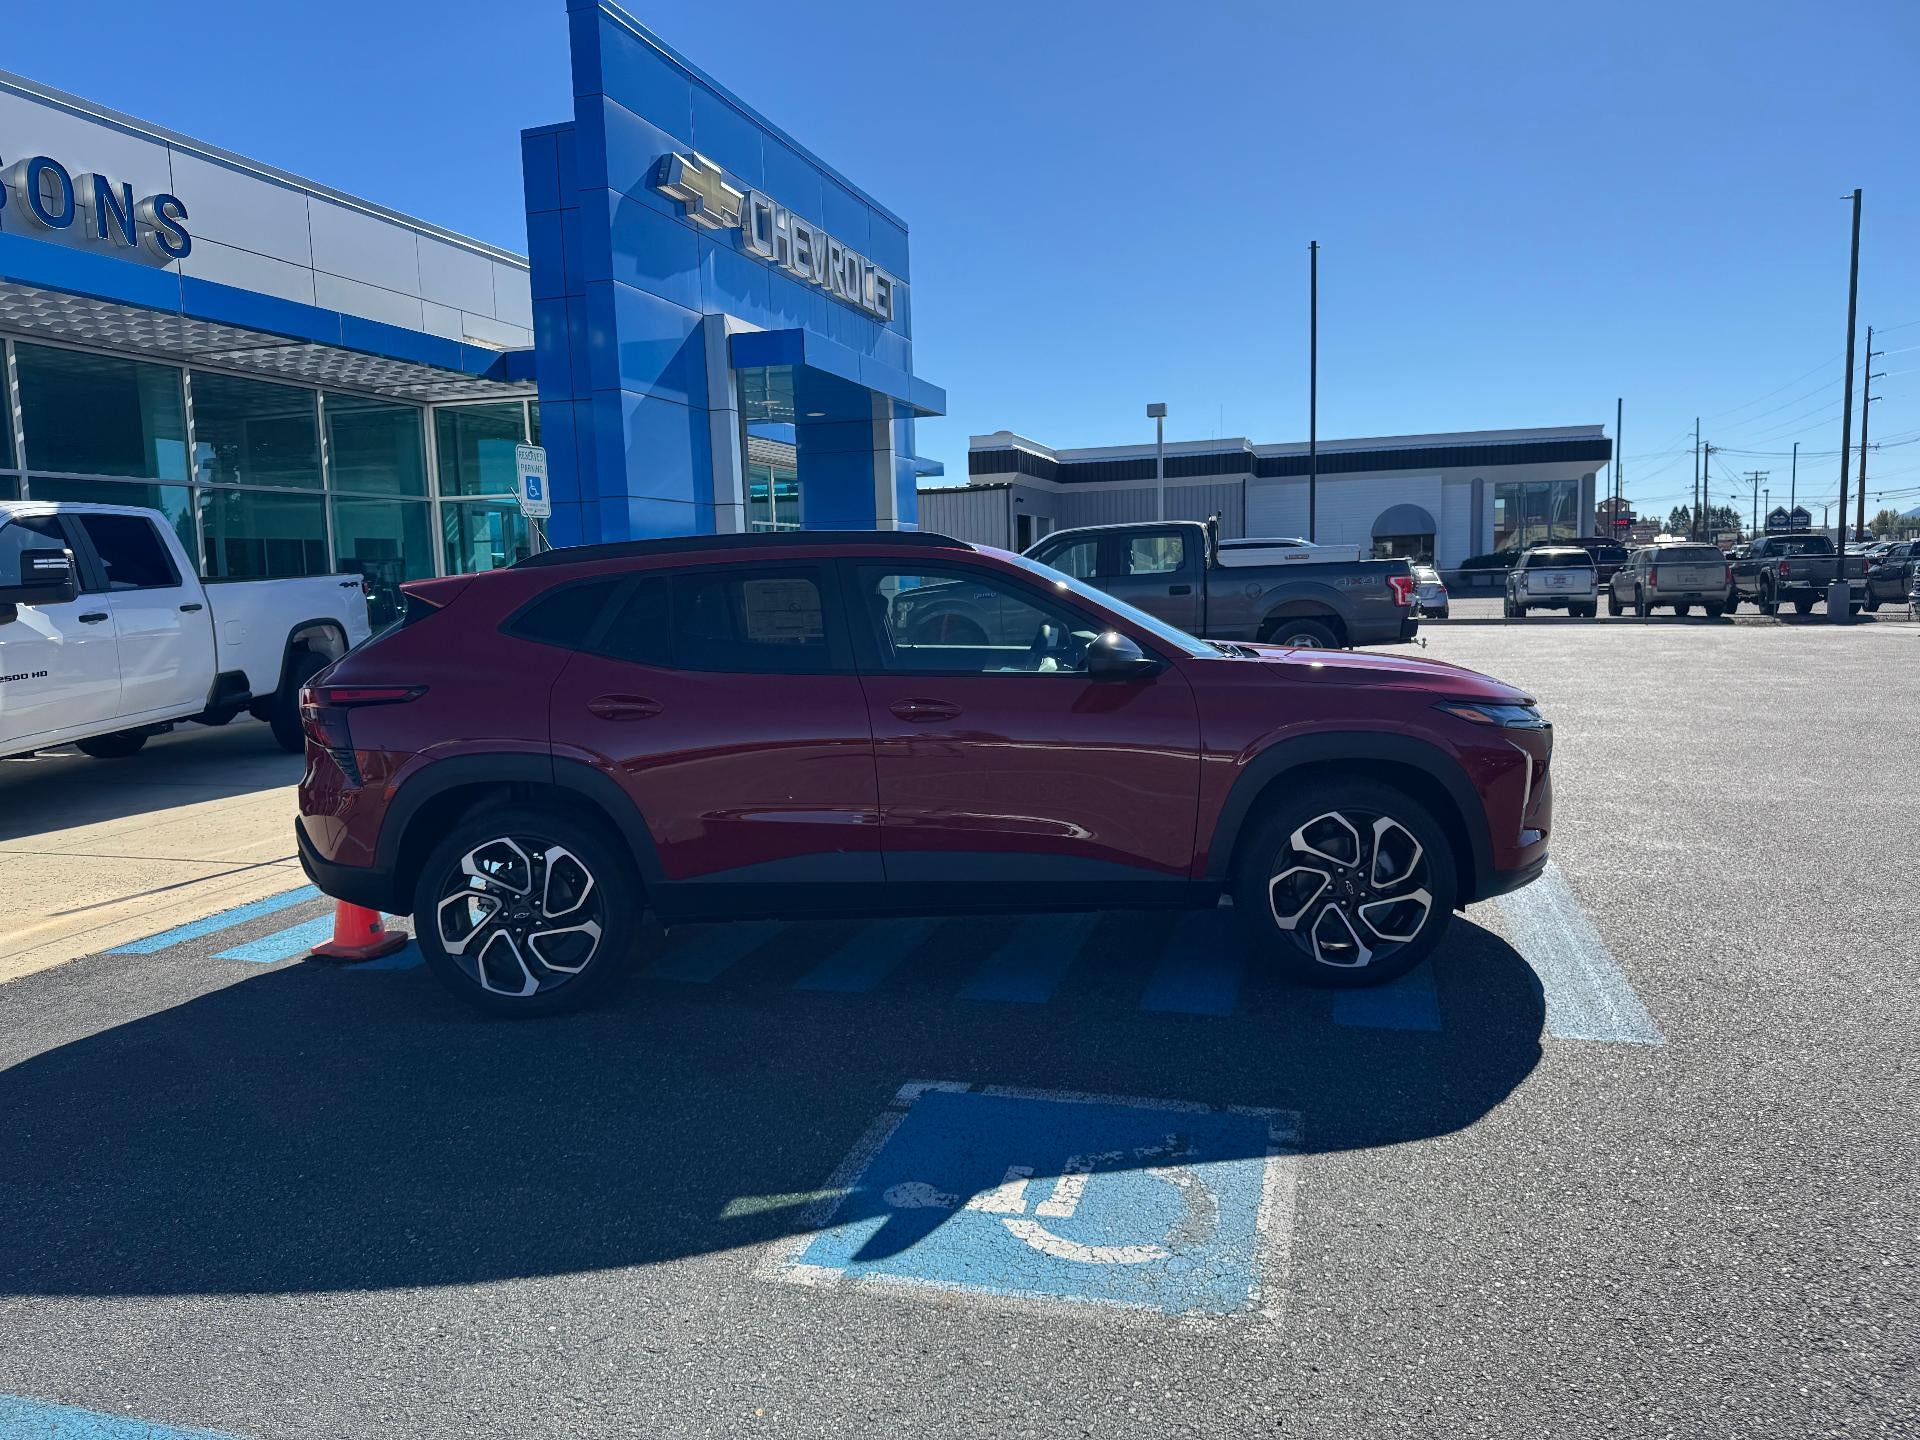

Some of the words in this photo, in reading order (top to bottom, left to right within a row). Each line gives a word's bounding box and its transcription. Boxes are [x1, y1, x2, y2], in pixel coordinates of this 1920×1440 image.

[0, 155, 192, 259] ONS
[741, 190, 897, 321] CHEVROLET
[519, 450, 544, 462] RESERVED
[520, 463, 544, 474] PARKING
[31, 670, 48, 679] HD
